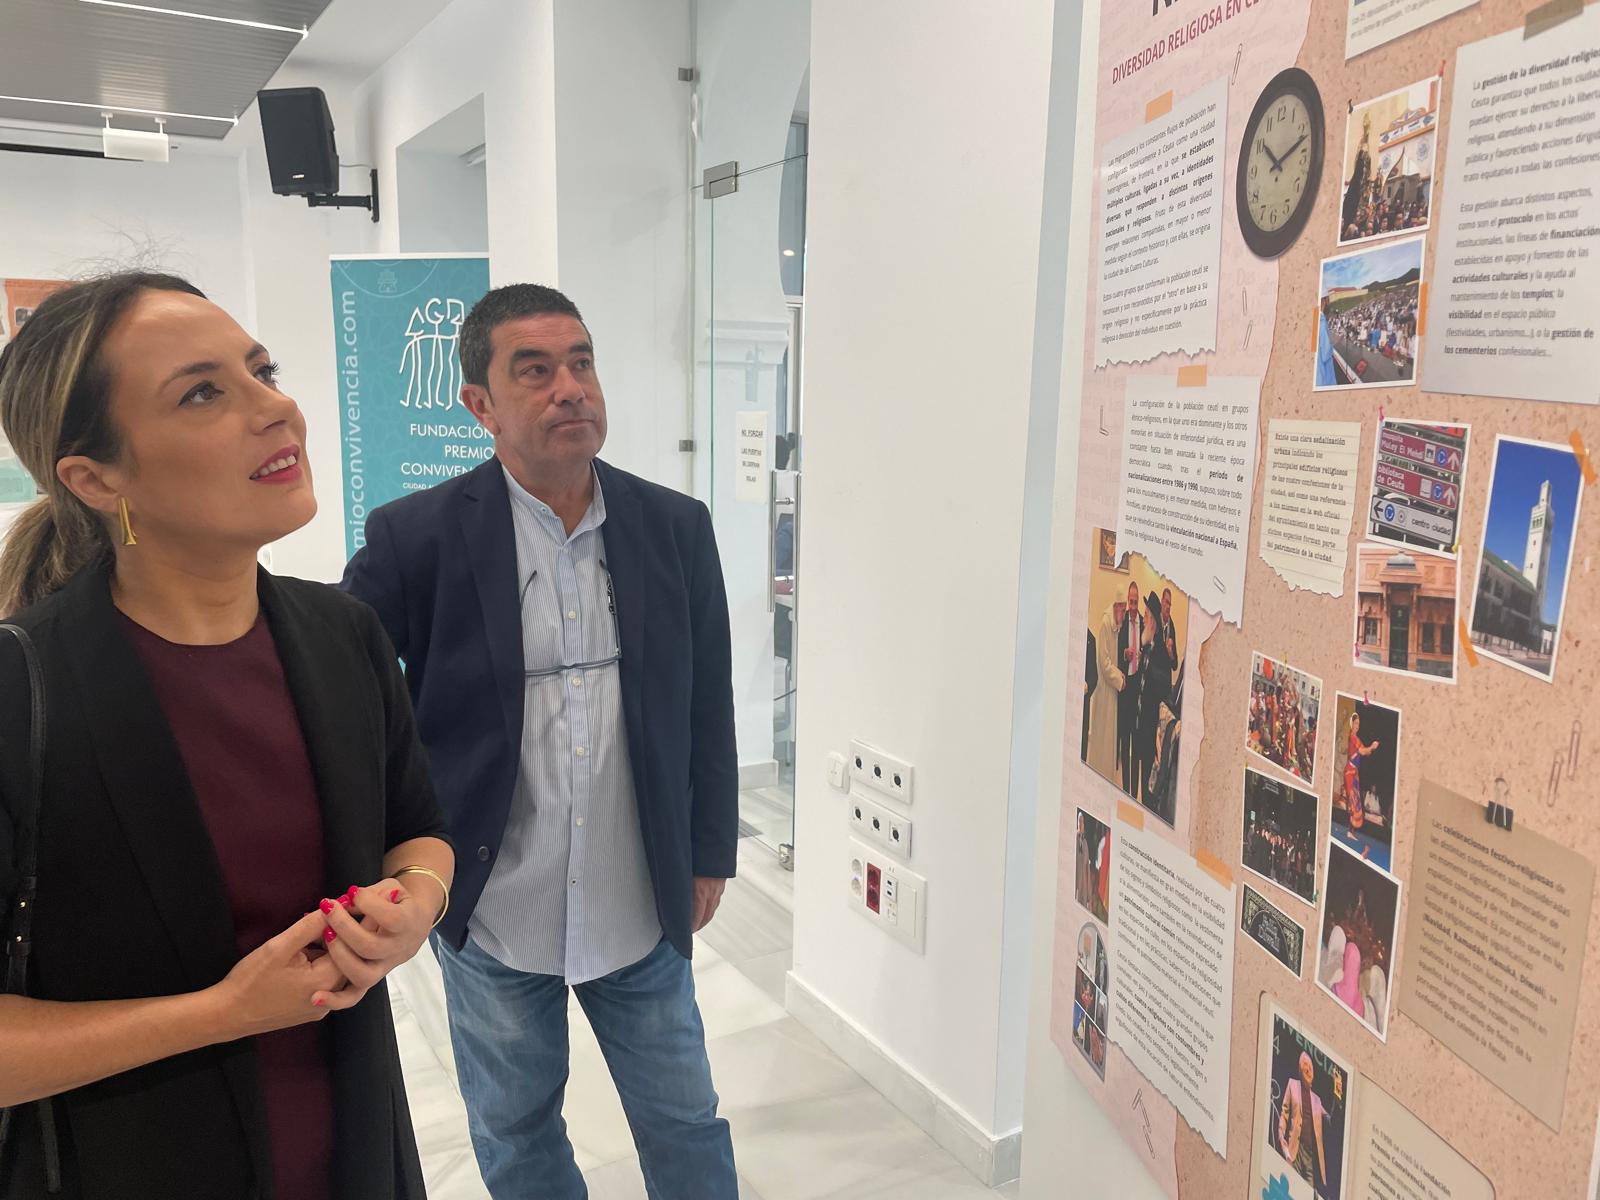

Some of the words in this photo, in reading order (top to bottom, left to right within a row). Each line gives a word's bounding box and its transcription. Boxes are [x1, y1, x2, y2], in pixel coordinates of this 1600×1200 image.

[1113, 40, 1165, 84] DIVERSIDAD
[1168, 6, 1222, 53] RELIGIOSA
[1226, 0, 1241, 19] EN
[1277, 106, 1286, 122] 12
[1251, 166, 1257, 179] 9
[1252, 190, 1259, 203] 8
[1260, 205, 1266, 220] 7
[1270, 208, 1277, 224] 6
[1539, 230, 1548, 240] de
[1566, 248, 1577, 258] de
[1536, 270, 1543, 280] la
[1500, 290, 1509, 300] de
[1557, 288, 1564, 298] la
[1543, 328, 1550, 338] la
[1583, 329, 1594, 338] de
[444, 445, 495, 460] PREMIO
